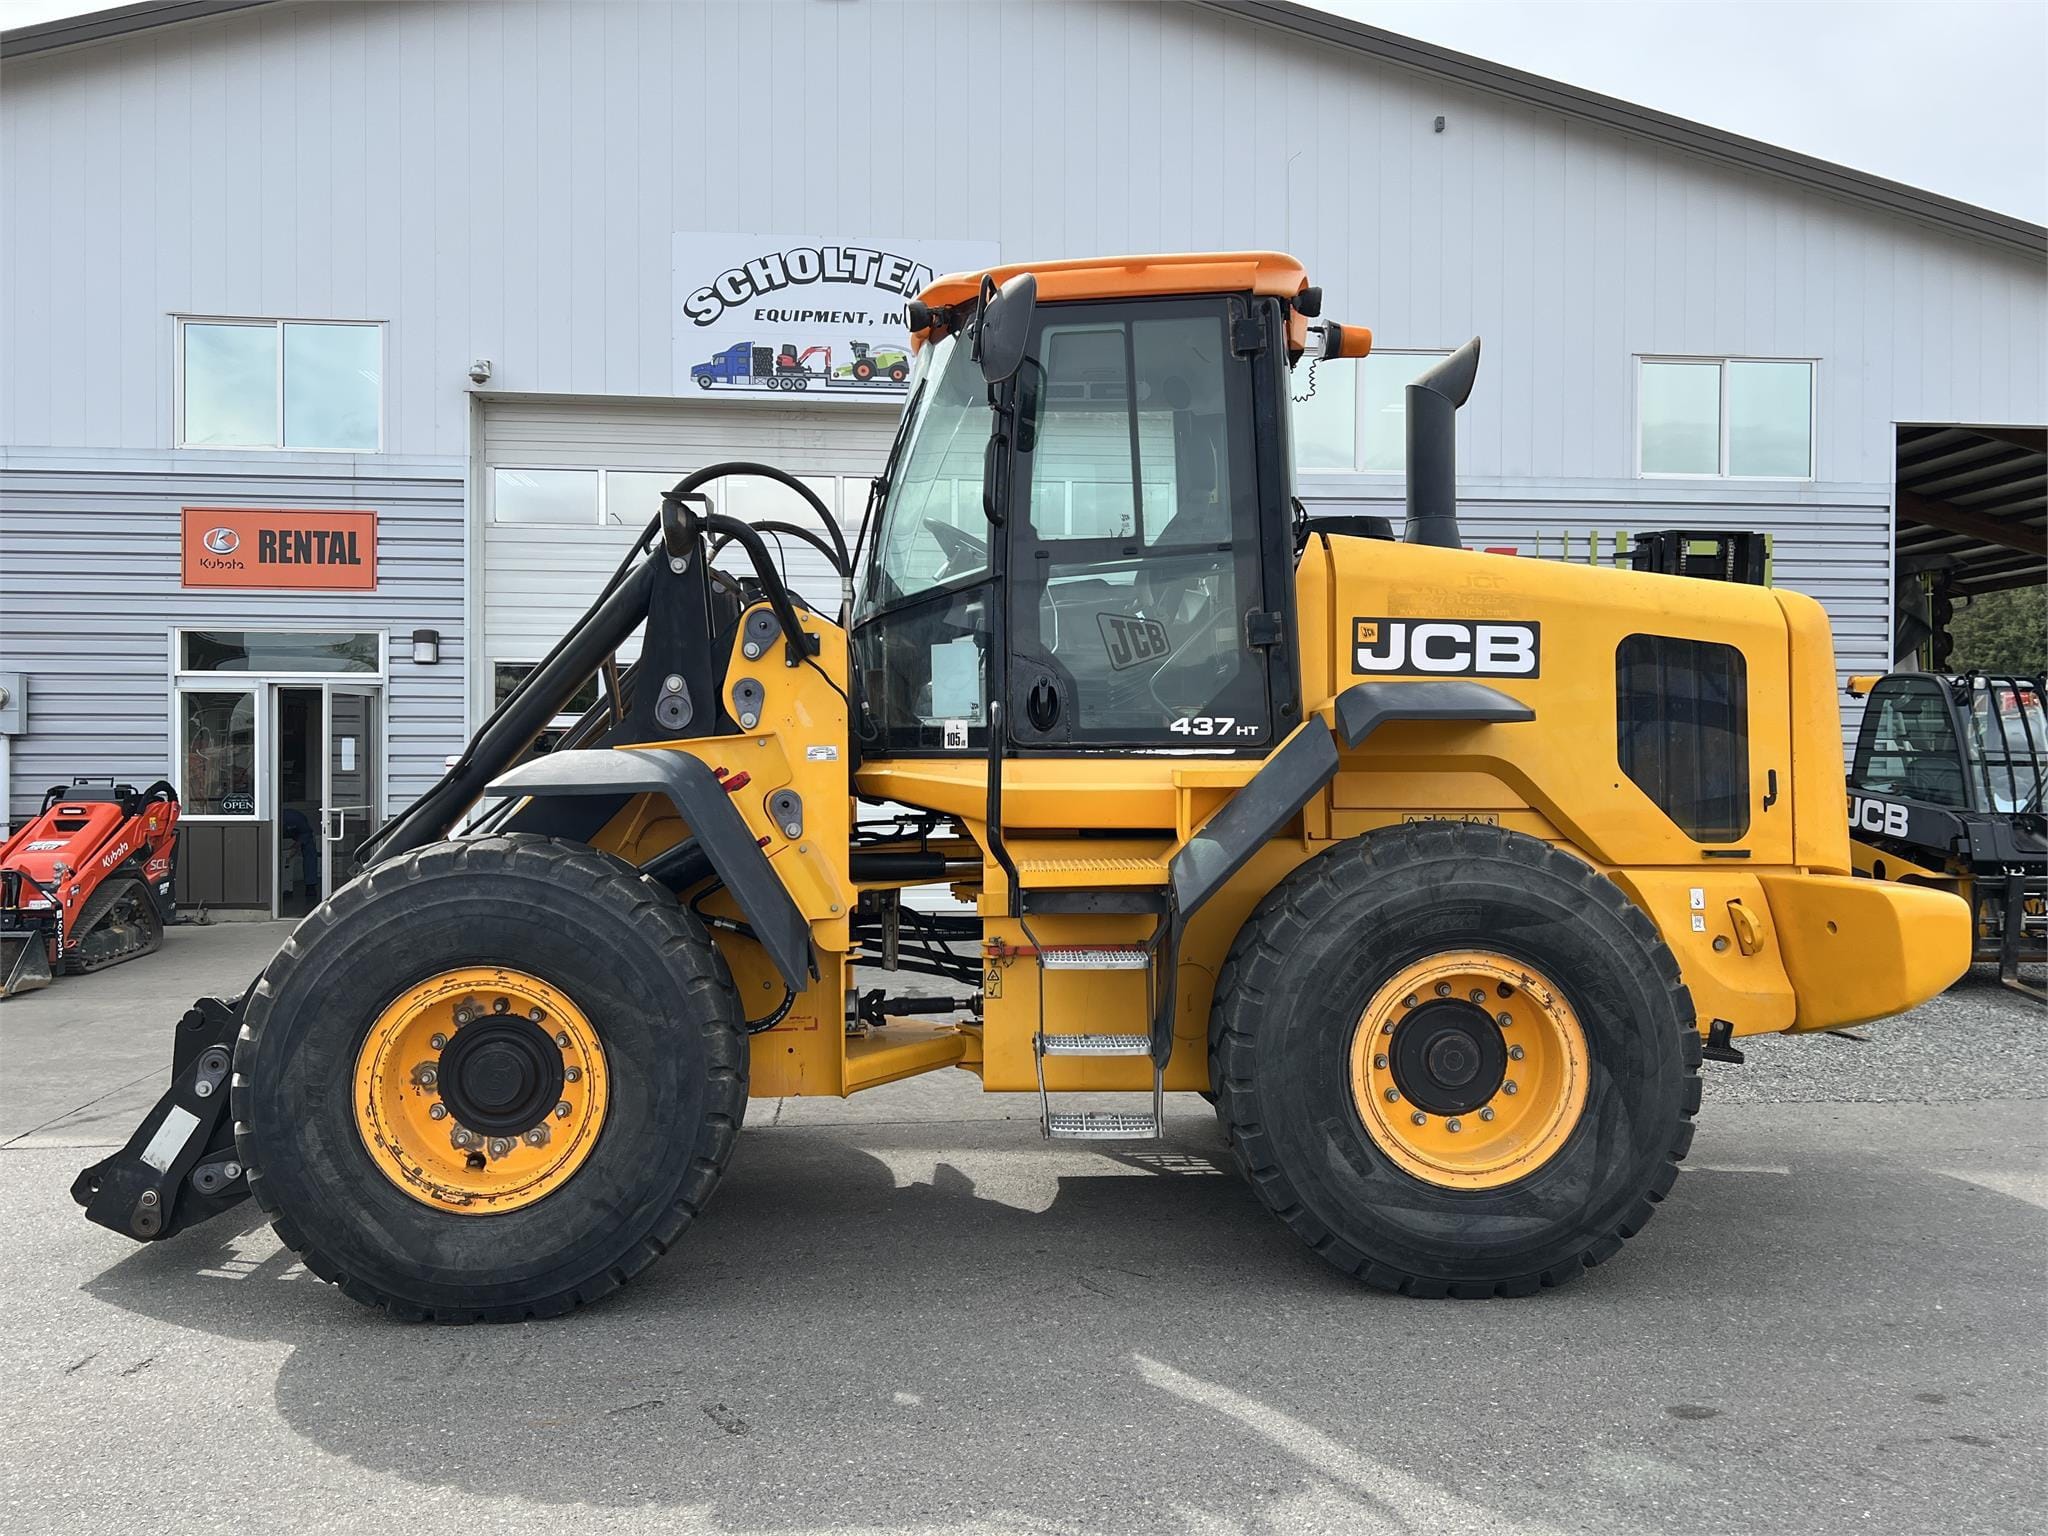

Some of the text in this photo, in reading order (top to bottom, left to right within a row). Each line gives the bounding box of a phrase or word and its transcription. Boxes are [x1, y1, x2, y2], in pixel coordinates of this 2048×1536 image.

[753, 308, 907, 326] EQUIPMENT, IN
[258, 529, 361, 565] RENTAL
[200, 558, 245, 569] Kubota
[1109, 618, 1166, 665] JCB
[1357, 623, 1536, 674] JCB
[1170, 717, 1259, 736] 437 HT
[946, 732, 961, 747] 105
[223, 802, 254, 810] OPEN
[1848, 796, 1909, 838] JCB
[102, 842, 129, 868] Kubota
[150, 859, 168, 870] SCL
